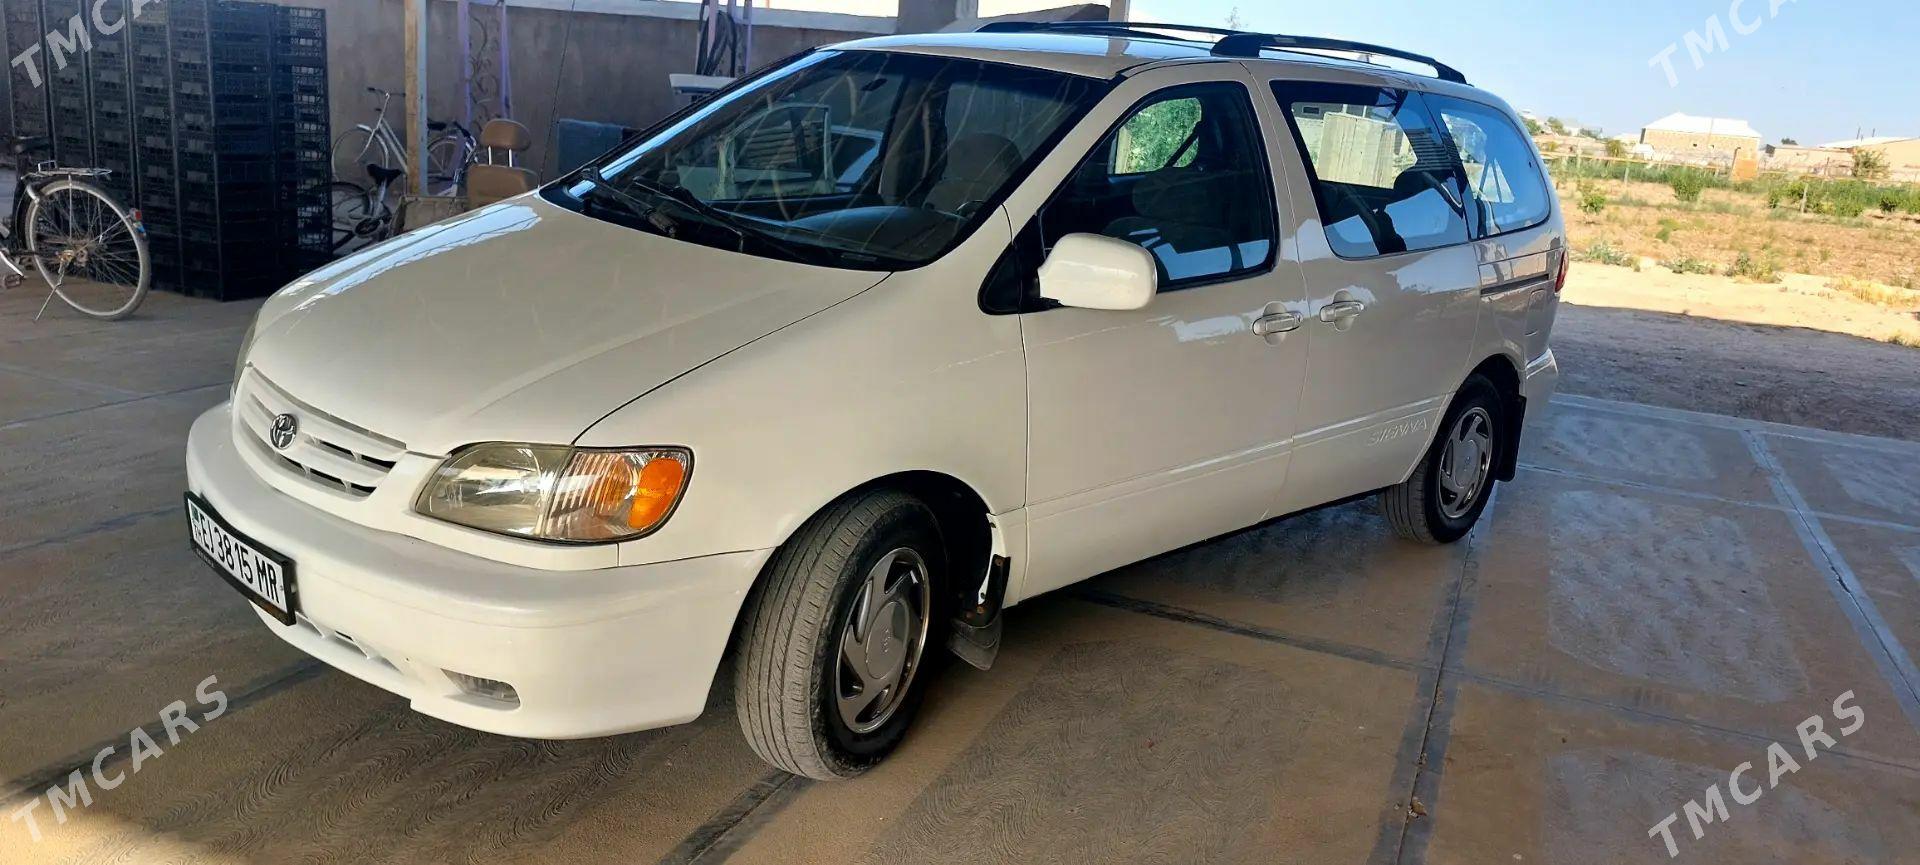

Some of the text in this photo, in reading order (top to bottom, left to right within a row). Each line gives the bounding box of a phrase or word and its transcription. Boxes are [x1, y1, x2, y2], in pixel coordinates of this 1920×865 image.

[1367, 417, 1427, 446] SIENNA
[214, 526, 254, 584] 3815
[255, 555, 280, 604] MR
